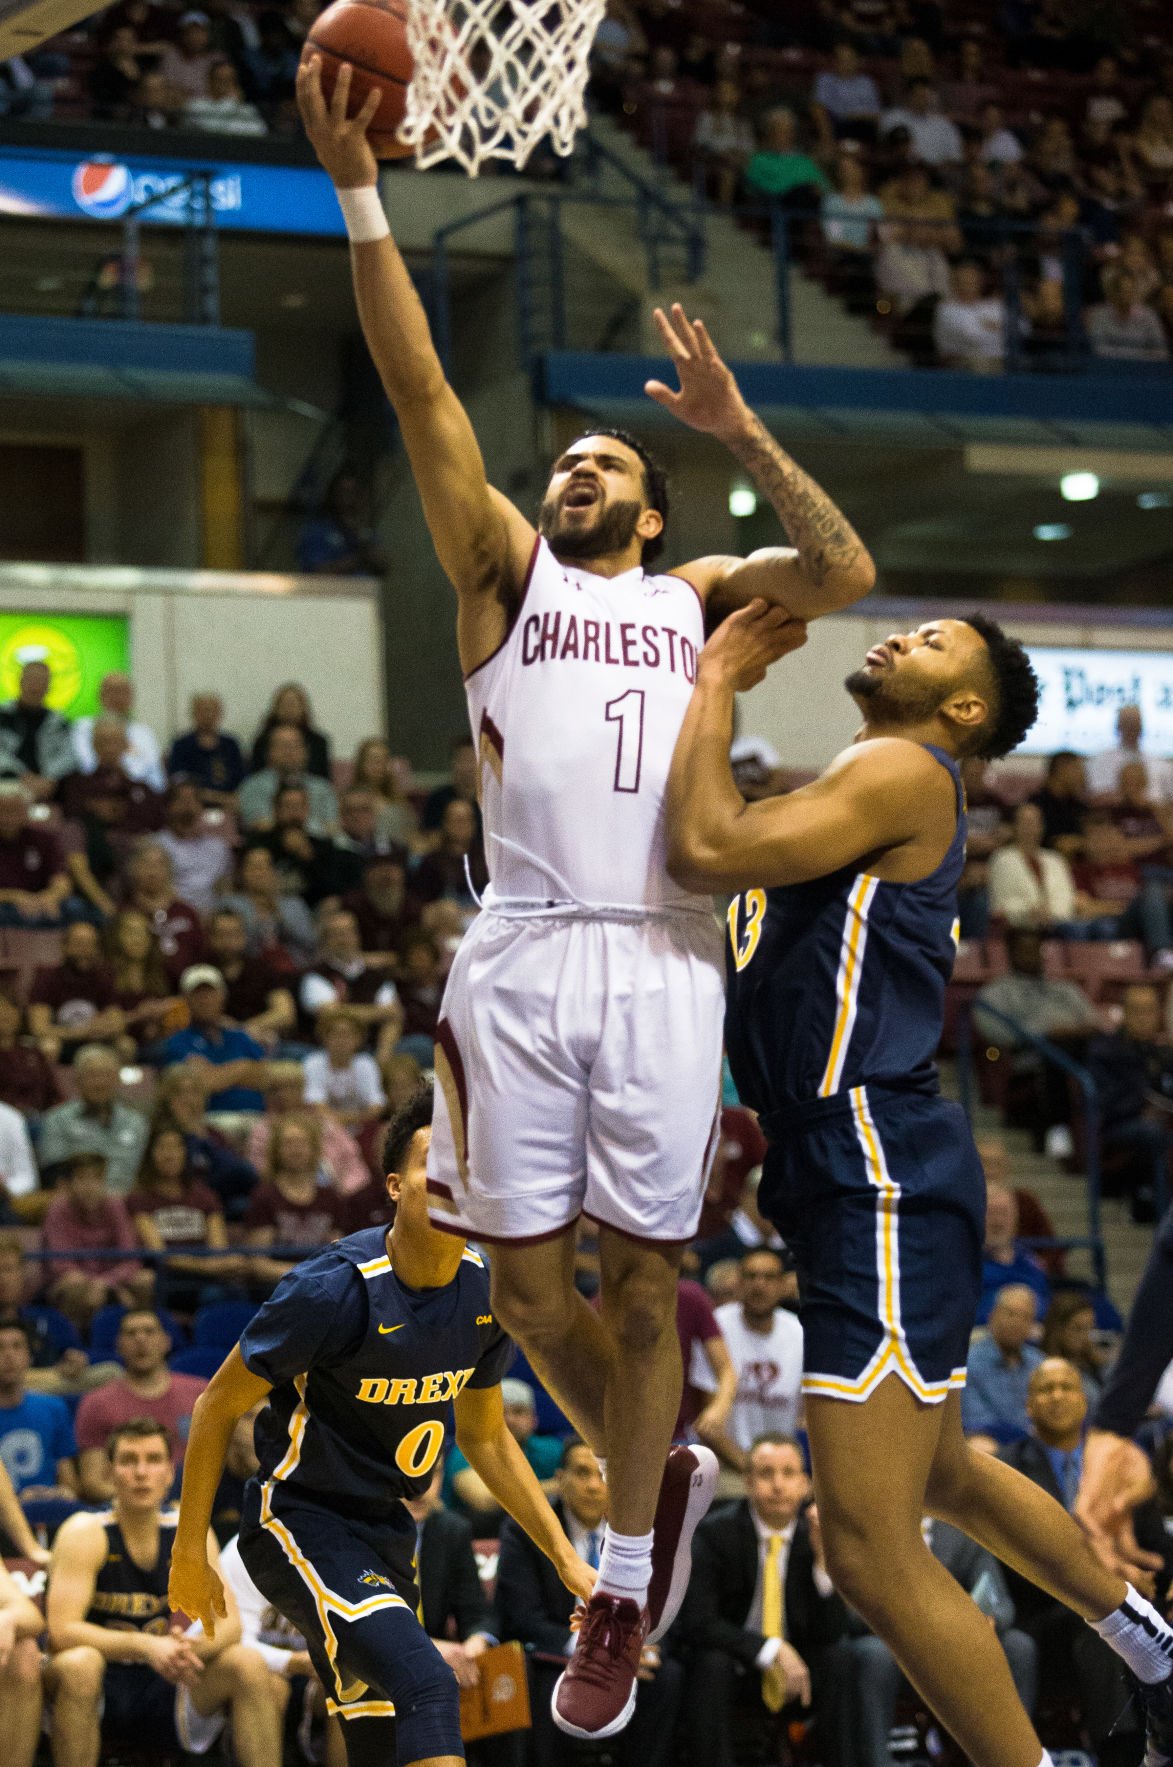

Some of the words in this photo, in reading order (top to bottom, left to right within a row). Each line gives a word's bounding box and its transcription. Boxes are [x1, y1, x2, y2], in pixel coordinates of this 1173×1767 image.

[521, 610, 699, 686] CHARLESTO
[605, 688, 646, 794] 1
[727, 887, 767, 972] 13
[475, 1314, 493, 1326] CAA
[395, 1420, 445, 1478] 0
